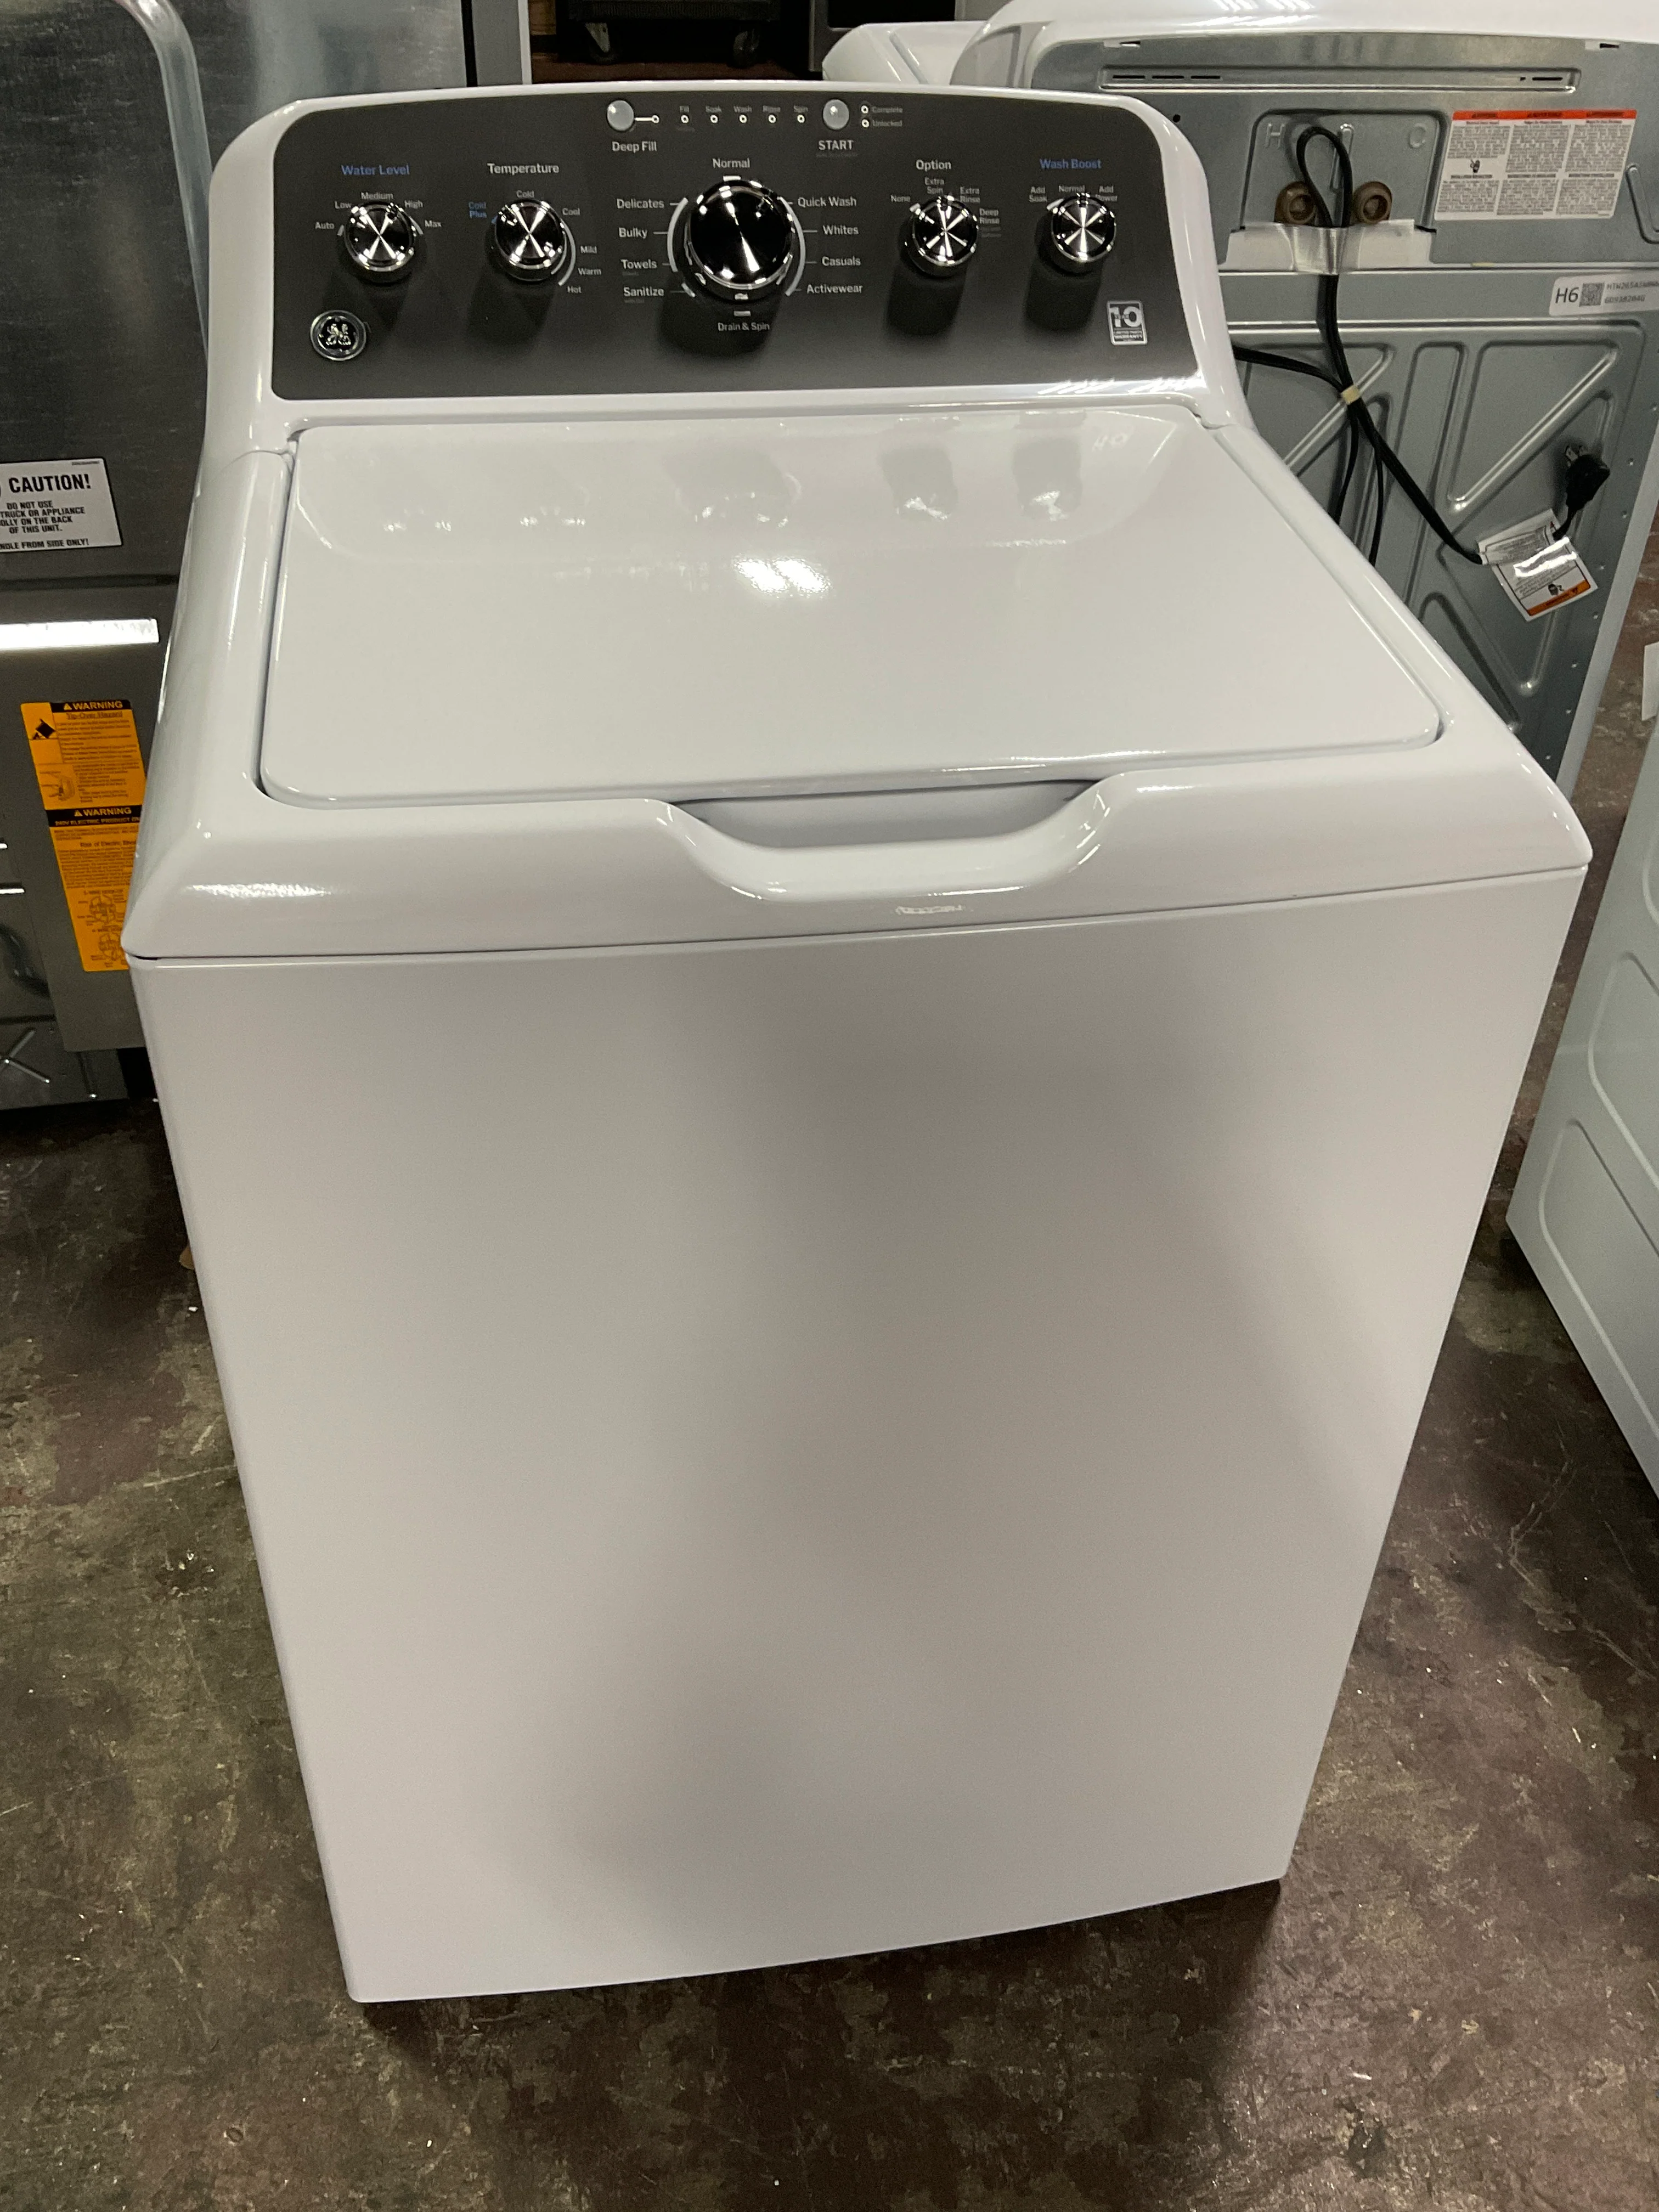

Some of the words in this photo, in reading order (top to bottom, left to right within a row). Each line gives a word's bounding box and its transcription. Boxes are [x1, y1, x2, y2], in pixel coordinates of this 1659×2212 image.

[612, 141, 640, 153] Deep
[641, 141, 657, 151] Fill
[819, 140, 854, 150] START
[713, 157, 751, 168] Normal
[916, 159, 952, 171] Option
[1040, 159, 1069, 169] Wash
[1071, 159, 1102, 168] Boost
[341, 165, 376, 175] Water
[379, 165, 410, 175] Level
[487, 163, 560, 175] Temperature
[924, 176, 945, 185] Extra
[960, 187, 980, 195] Extra
[1058, 184, 1085, 193] Normal
[334, 201, 352, 209] Low
[404, 200, 424, 210] High
[617, 199, 664, 208] Delicates
[798, 196, 827, 208] Quick
[828, 196, 857, 207] Wash
[562, 207, 580, 216] Cool
[979, 208, 999, 216] Deep
[424, 219, 442, 228] Max
[618, 227, 647, 239] Bulky
[823, 225, 859, 235] Whites
[580, 246, 597, 254] Mild
[620, 259, 657, 269] Towels
[822, 256, 861, 266] Casuals
[623, 286, 664, 296] Sanitize
[806, 284, 864, 294] Activewear
[1555, 286, 1579, 303] H6
[1109, 306, 1142, 328] 10
[718, 322, 741, 331] Drain
[742, 322, 750, 331] &
[751, 322, 770, 332] Spin
[8, 473, 92, 494] CAUTION!
[20, 501, 36, 509] NOT
[37, 500, 53, 509] USE
[42, 506, 86, 516] APPLIANCE
[0, 518, 18, 527] OLLY
[51, 516, 74, 524] BACK
[42, 524, 63, 533] UNIT.
[66, 538, 89, 546] ONLY!
[72, 700, 123, 710] WARNING
[83, 807, 132, 817] WARNING
